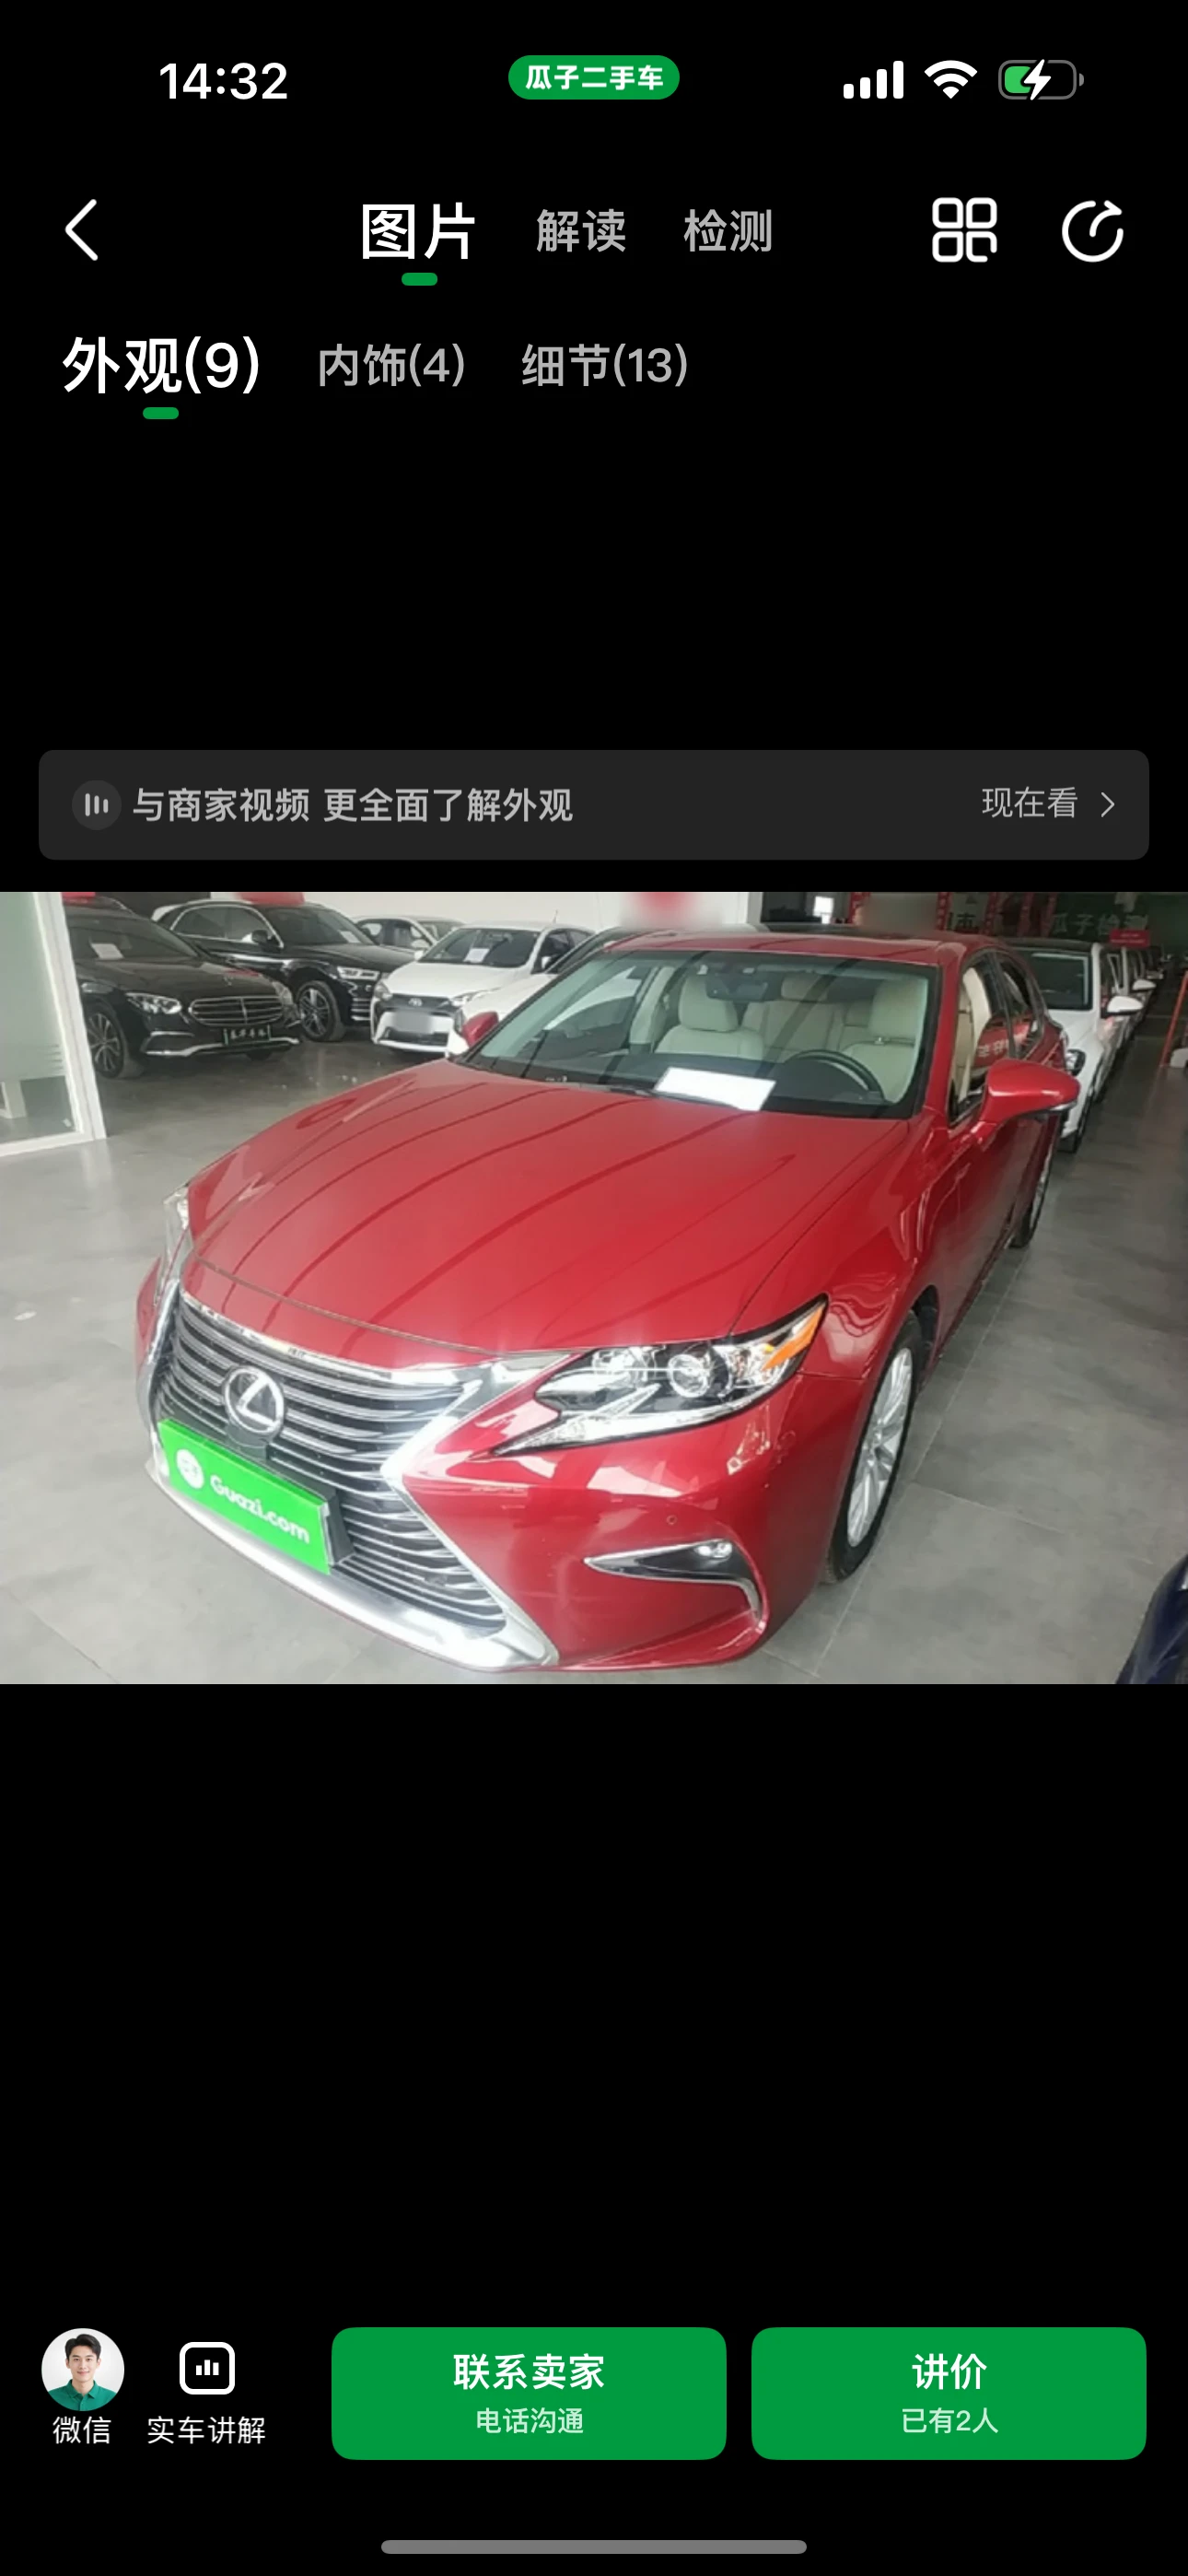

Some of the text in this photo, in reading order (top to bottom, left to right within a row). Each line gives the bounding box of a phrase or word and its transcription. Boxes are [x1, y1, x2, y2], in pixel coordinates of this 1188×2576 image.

[160, 63, 288, 100] 14:32
[525, 64, 664, 91] 瓜子二手车
[362, 202, 476, 260] 图片
[536, 208, 626, 253] 解读
[683, 208, 773, 252] 检测
[63, 336, 260, 394] 外观(9)
[320, 344, 465, 387] 内饰(4)
[522, 344, 688, 387] 细节(13)
[134, 788, 574, 823] 与商家视频 更全面了解外观
[982, 786, 1078, 819] 现在看
[210, 1474, 309, 1544] Guazi.com
[452, 2352, 605, 2390] 联系卖家
[912, 2352, 988, 2390] 讲价
[52, 2415, 112, 2445] 微信
[146, 2415, 266, 2445] 实车讲解
[476, 2406, 584, 2434] 电话沟通
[902, 2406, 999, 2434] 已有2人
